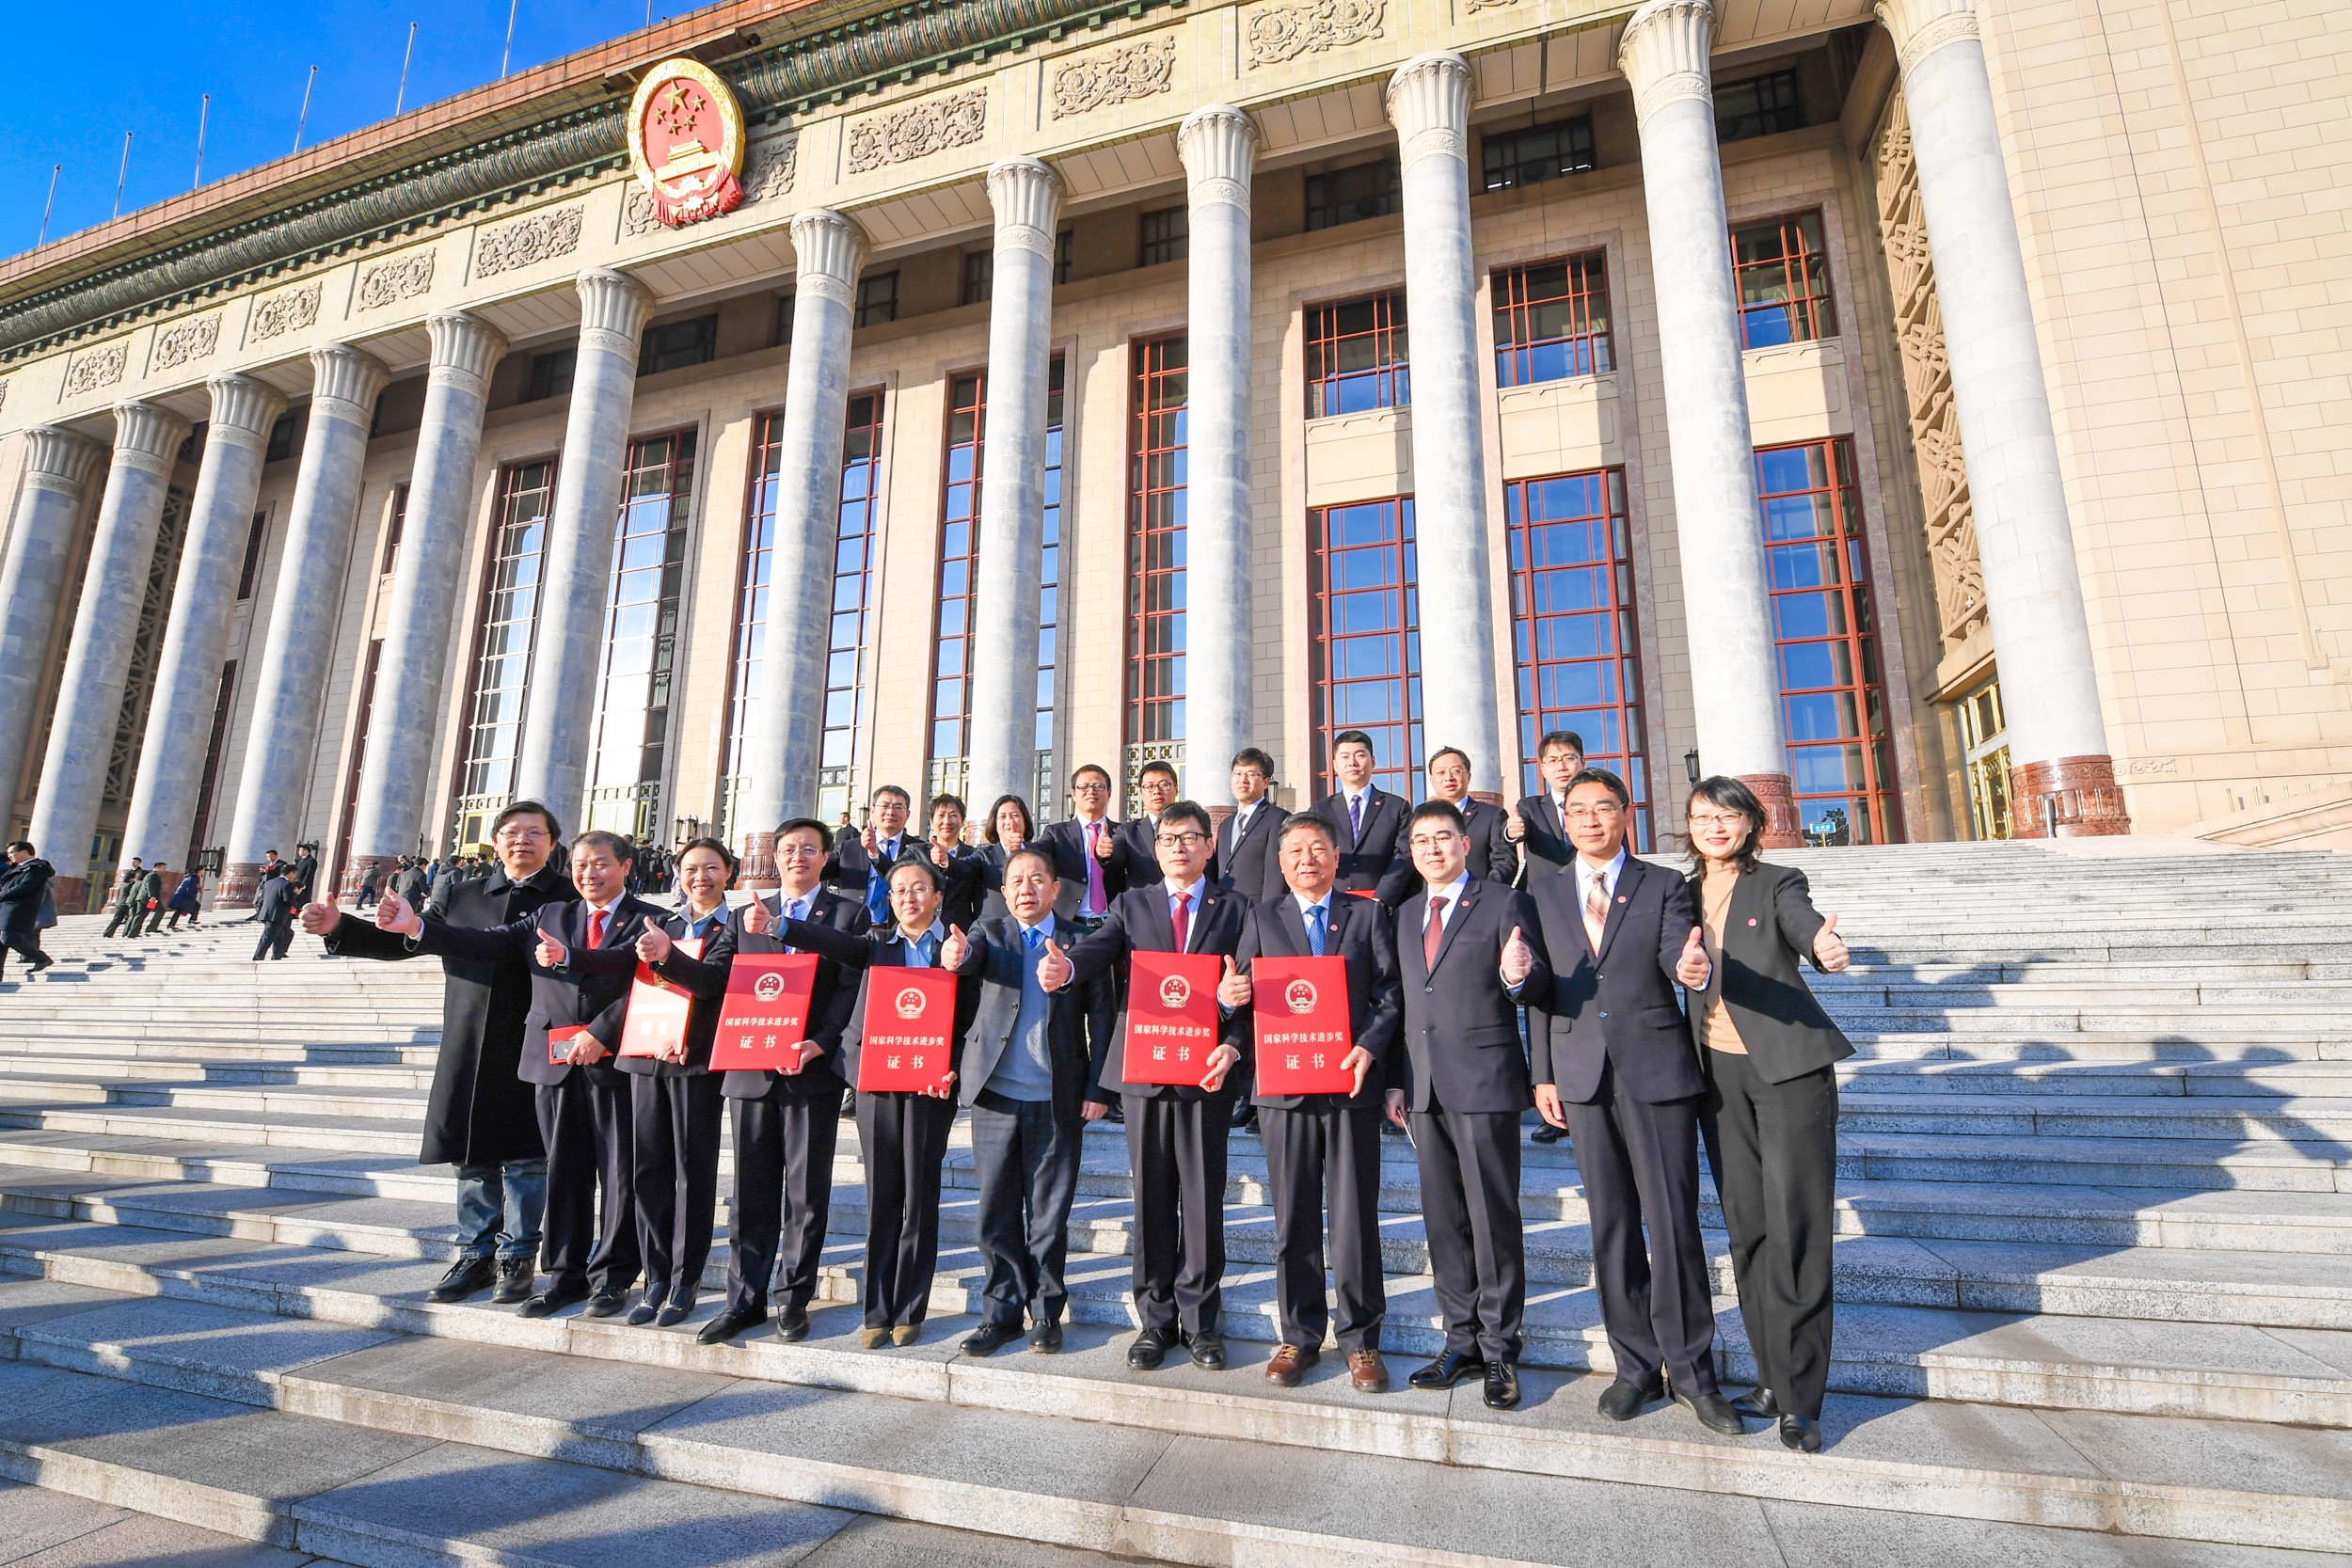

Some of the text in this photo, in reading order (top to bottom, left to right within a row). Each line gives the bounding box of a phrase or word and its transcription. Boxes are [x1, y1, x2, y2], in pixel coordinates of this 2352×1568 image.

[725, 1017, 799, 1027] 国家科学技术进步奖
[1135, 1023, 1210, 1037] 国家科学技术进步奖
[869, 1035, 945, 1046] 国家科学技术进步奖
[1264, 1031, 1343, 1044] 国家科学技术进步奖
